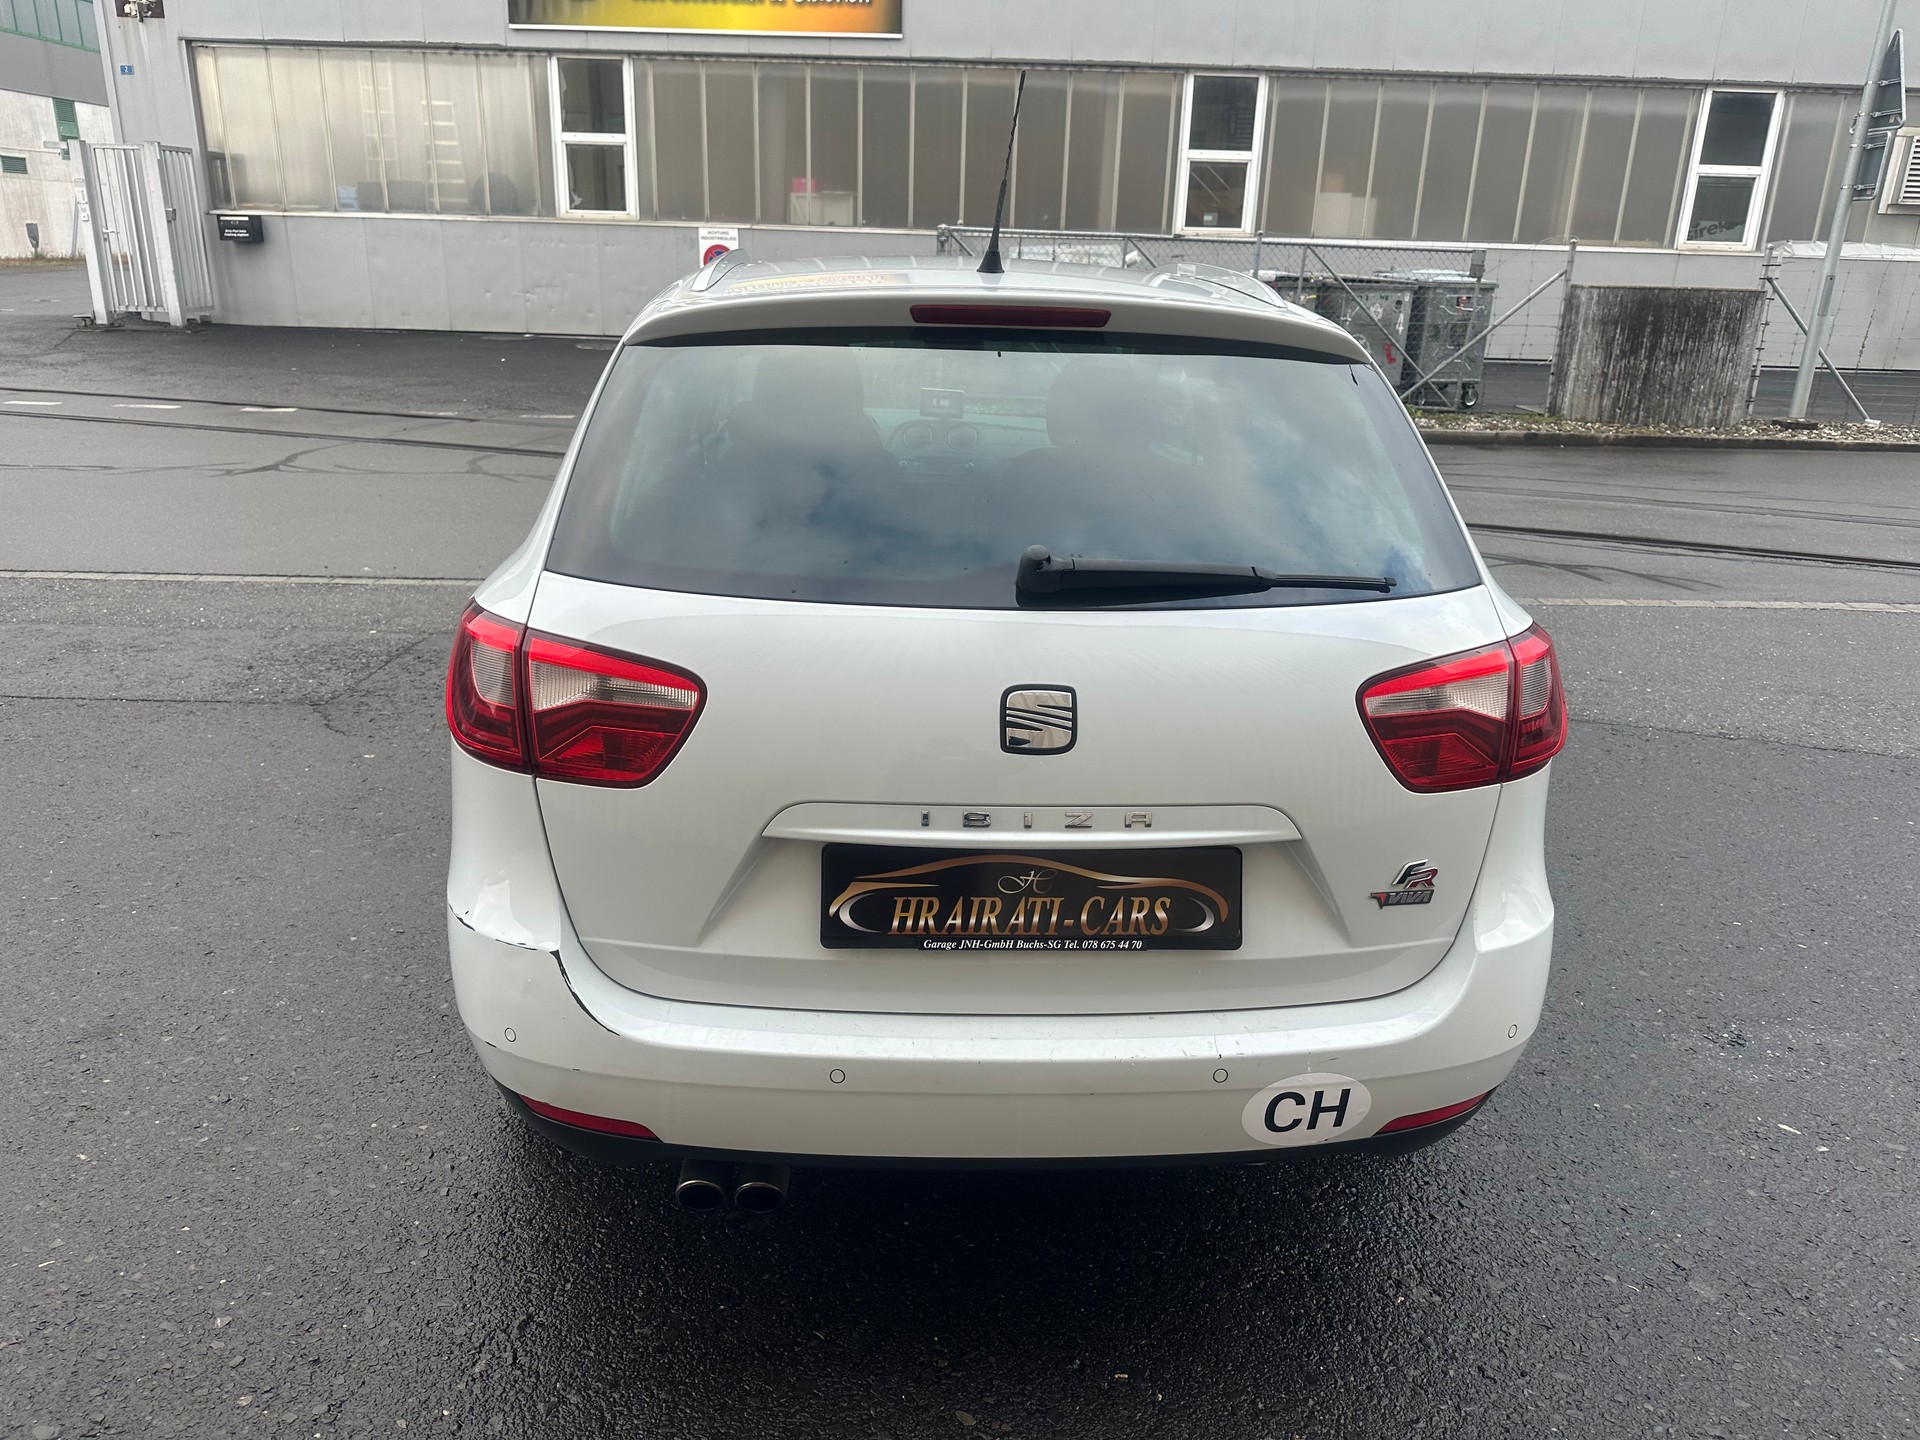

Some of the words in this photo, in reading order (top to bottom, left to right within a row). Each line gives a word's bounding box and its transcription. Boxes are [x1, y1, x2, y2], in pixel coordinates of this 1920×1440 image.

[921, 810, 1152, 828] IBIZA
[923, 939, 957, 951] Garage
[958, 939, 1014, 950] JNH-GmbH
[1016, 939, 1062, 950] Buchs-SG
[1064, 940, 1080, 950] Tel.
[1082, 940, 1099, 950] 078
[1100, 940, 1116, 950] 675
[1117, 940, 1130, 950] 44
[1131, 940, 1143, 950] 70
[1264, 1088, 1352, 1133] CH
